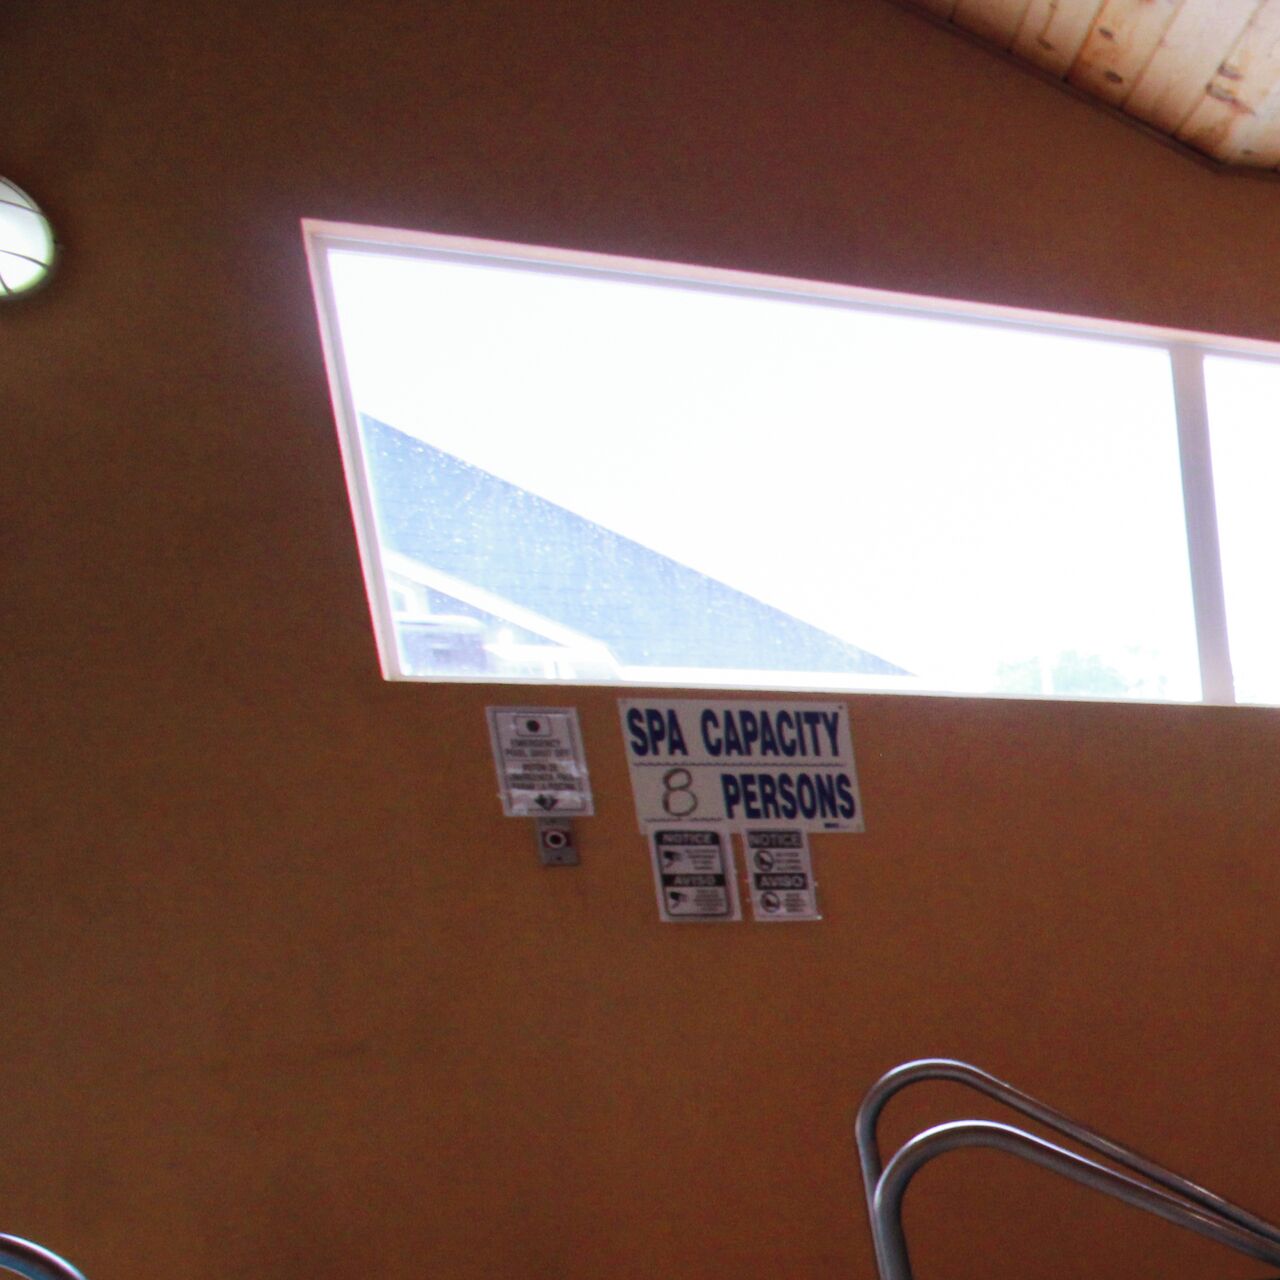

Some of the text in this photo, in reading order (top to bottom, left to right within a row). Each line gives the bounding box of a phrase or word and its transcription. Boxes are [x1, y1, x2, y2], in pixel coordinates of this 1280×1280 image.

[626, 707, 840, 757] SPA CAPACITY
[662, 768, 698, 817] 8
[721, 772, 856, 820] PERSONS
[662, 834, 713, 845] NOTICE
[749, 834, 802, 847] NOTICE
[760, 876, 805, 888] AVISO
